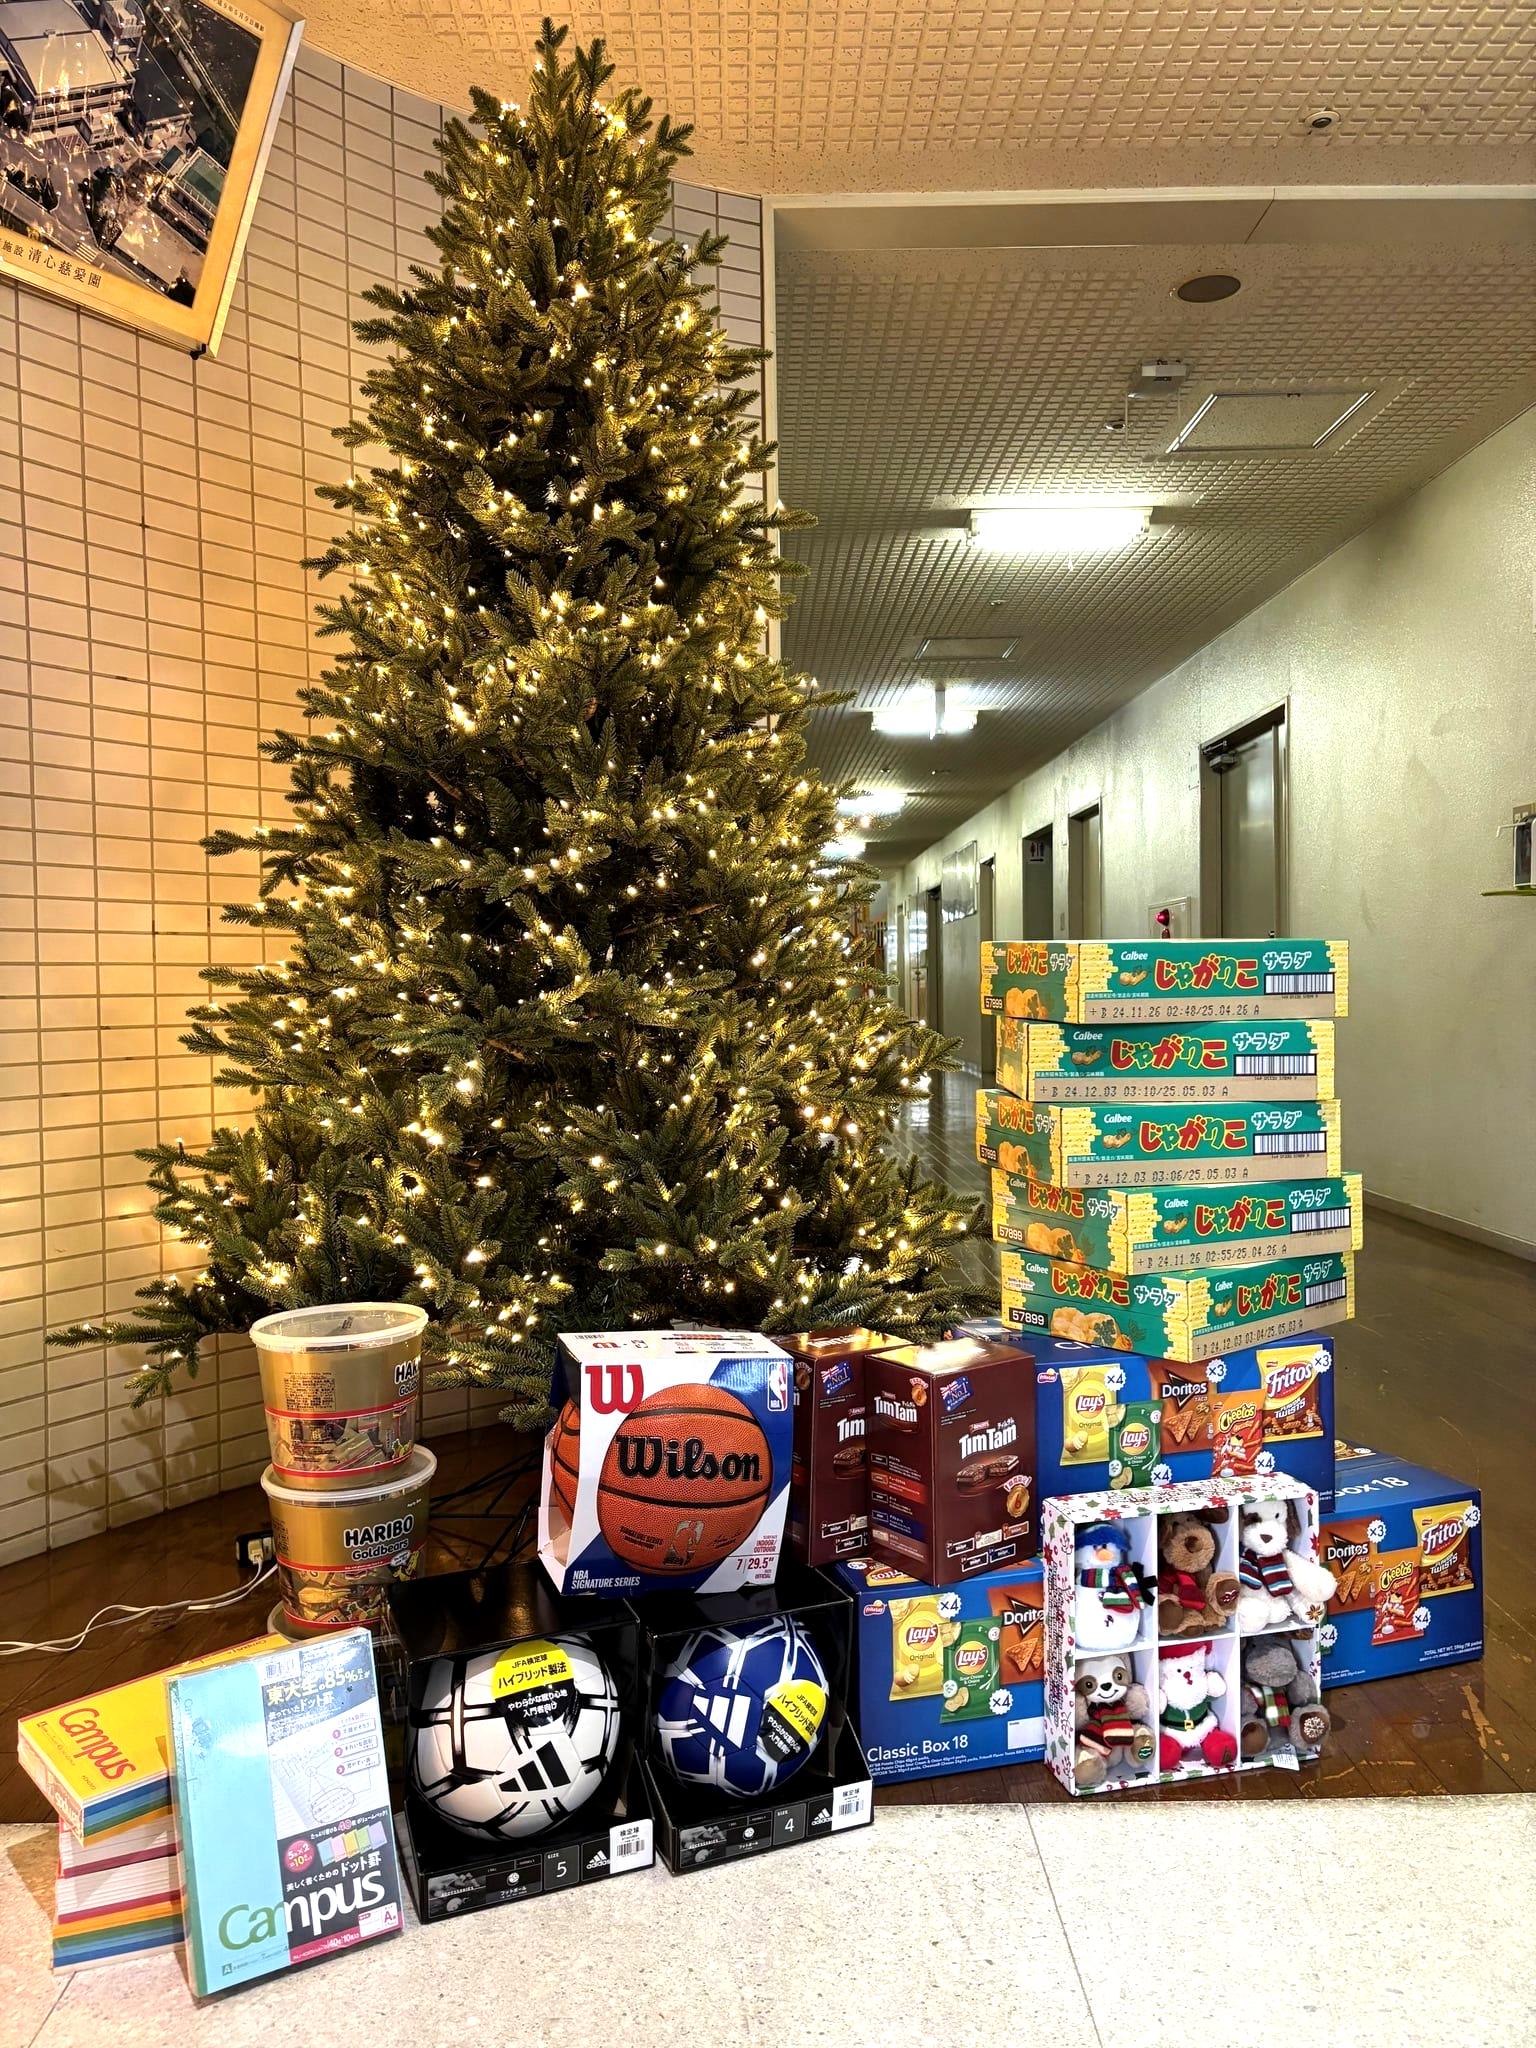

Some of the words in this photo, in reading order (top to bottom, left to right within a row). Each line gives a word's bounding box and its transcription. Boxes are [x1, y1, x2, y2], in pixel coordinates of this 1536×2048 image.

[1050, 952, 1076, 971] サラダ
[1121, 951, 1148, 961] Calbee
[1155, 953, 1259, 991] じゃがりこ
[1263, 951, 1312, 971] サラダ
[1112, 1006, 1161, 1018] 24.11.26
[1166, 1004, 1249, 1017] 02:48/25.04.26
[1073, 1031, 1103, 1041] Calbee
[1110, 1033, 1228, 1070] じゃがりこ
[1232, 1032, 1290, 1052] サラダ
[1065, 1086, 1117, 1098] 24.12.03
[1123, 1085, 1216, 1097] 03:10/25.05.03
[1104, 1114, 1132, 1123] Calbee
[1139, 1115, 1247, 1152] じゃがりこ
[1251, 1111, 1302, 1130] サラダ
[1096, 1171, 1147, 1184] 24.12.03
[1028, 1182, 1084, 1218] じゃがりこ
[1087, 1197, 1120, 1219] サラダ
[1164, 1199, 1189, 1208] Calbee
[1195, 1196, 1285, 1236] じゃがりこ
[1289, 1188, 1331, 1209] サラダ
[999, 1225, 1023, 1241] 57899
[1026, 1262, 1049, 1274] Calbee
[1052, 1267, 1130, 1305] じゃがりこ
[1134, 1285, 1180, 1308] サラダ
[1215, 1281, 1234, 1292] Calbee
[1237, 1273, 1301, 1316] じゃがりこ
[1303, 1259, 1333, 1283] サラダ
[1012, 1310, 1045, 1325] 57899
[1266, 1363, 1312, 1397] Fritos
[1162, 1383, 1207, 1398] Doritos
[1077, 1394, 1105, 1412] Lay's
[1220, 1403, 1256, 1433] Cheetos
[1121, 1430, 1149, 1448] Lay's
[616, 1435, 762, 1481] Wilson
[1372, 1477, 1409, 1489] 18
[343, 1514, 414, 1548] HARIBO
[1422, 1519, 1463, 1554] Fritos
[352, 1539, 409, 1561] Goldbears
[1328, 1542, 1368, 1560] Doritos
[736, 1558, 743, 1570] 7
[571, 1579, 613, 1590] SIGNATURE
[614, 1577, 640, 1587] SERIES
[573, 1570, 589, 1580] NBA
[1380, 1561, 1413, 1591] Cheetos
[908, 1625, 938, 1644] Lay's
[512, 1654, 548, 1669] JFA検定球
[909, 1652, 935, 1661] Original
[957, 1647, 988, 1667] Lay's
[498, 1662, 567, 1689] ハイブリッド製法
[523, 1701, 558, 1718] 入門者向け
[777, 1693, 816, 1736] ハイブリッド製法
[59, 1707, 136, 1780] Campus
[867, 1743, 918, 1761] Classic
[922, 1740, 950, 1754] Box
[952, 1734, 968, 1749] 18
[784, 1818, 794, 1833] 4
[286, 1851, 381, 1892] 美しく書くためのドット罫
[556, 1861, 567, 1878] 5
[218, 1871, 385, 1950] Campus
